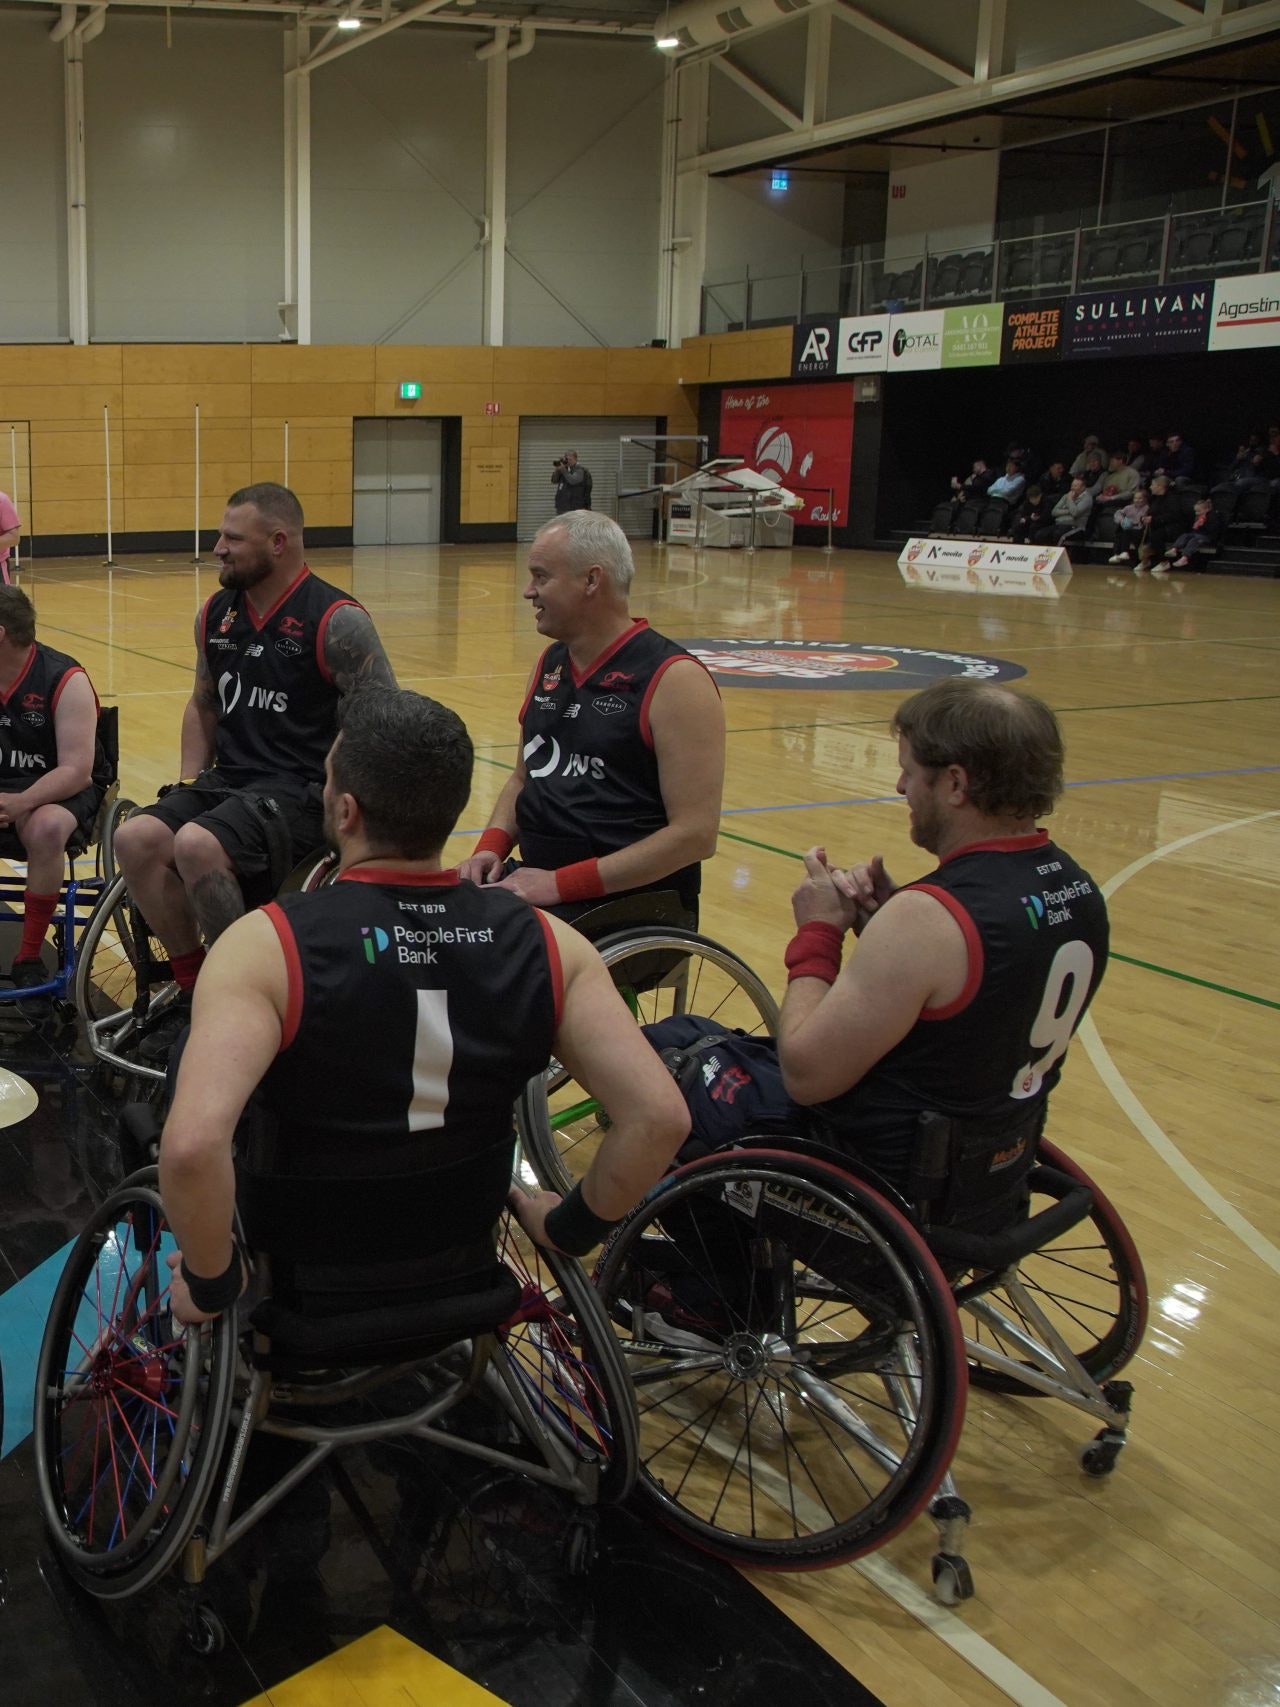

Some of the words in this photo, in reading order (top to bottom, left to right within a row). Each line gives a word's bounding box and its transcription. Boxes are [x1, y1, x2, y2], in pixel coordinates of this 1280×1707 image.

[1075, 292, 1206, 321] SULLIVAN
[1218, 296, 1280, 319] Agostin
[1008, 310, 1061, 326] COMPLETE
[1014, 323, 1058, 338] ATHLETE
[1012, 336, 1058, 351] PROJECT
[798, 362, 830, 372] ENERGY
[1006, 554, 1029, 562] novita
[247, 686, 289, 713] IWS
[10, 750, 47, 769] IWS
[561, 753, 606, 780] IWS
[1037, 865, 1050, 876] EST
[398, 901, 418, 912] EST
[1047, 905, 1072, 926] Bank
[398, 945, 438, 965] Bank
[1008, 939, 1094, 1100] 9
[407, 988, 454, 1132] 1
